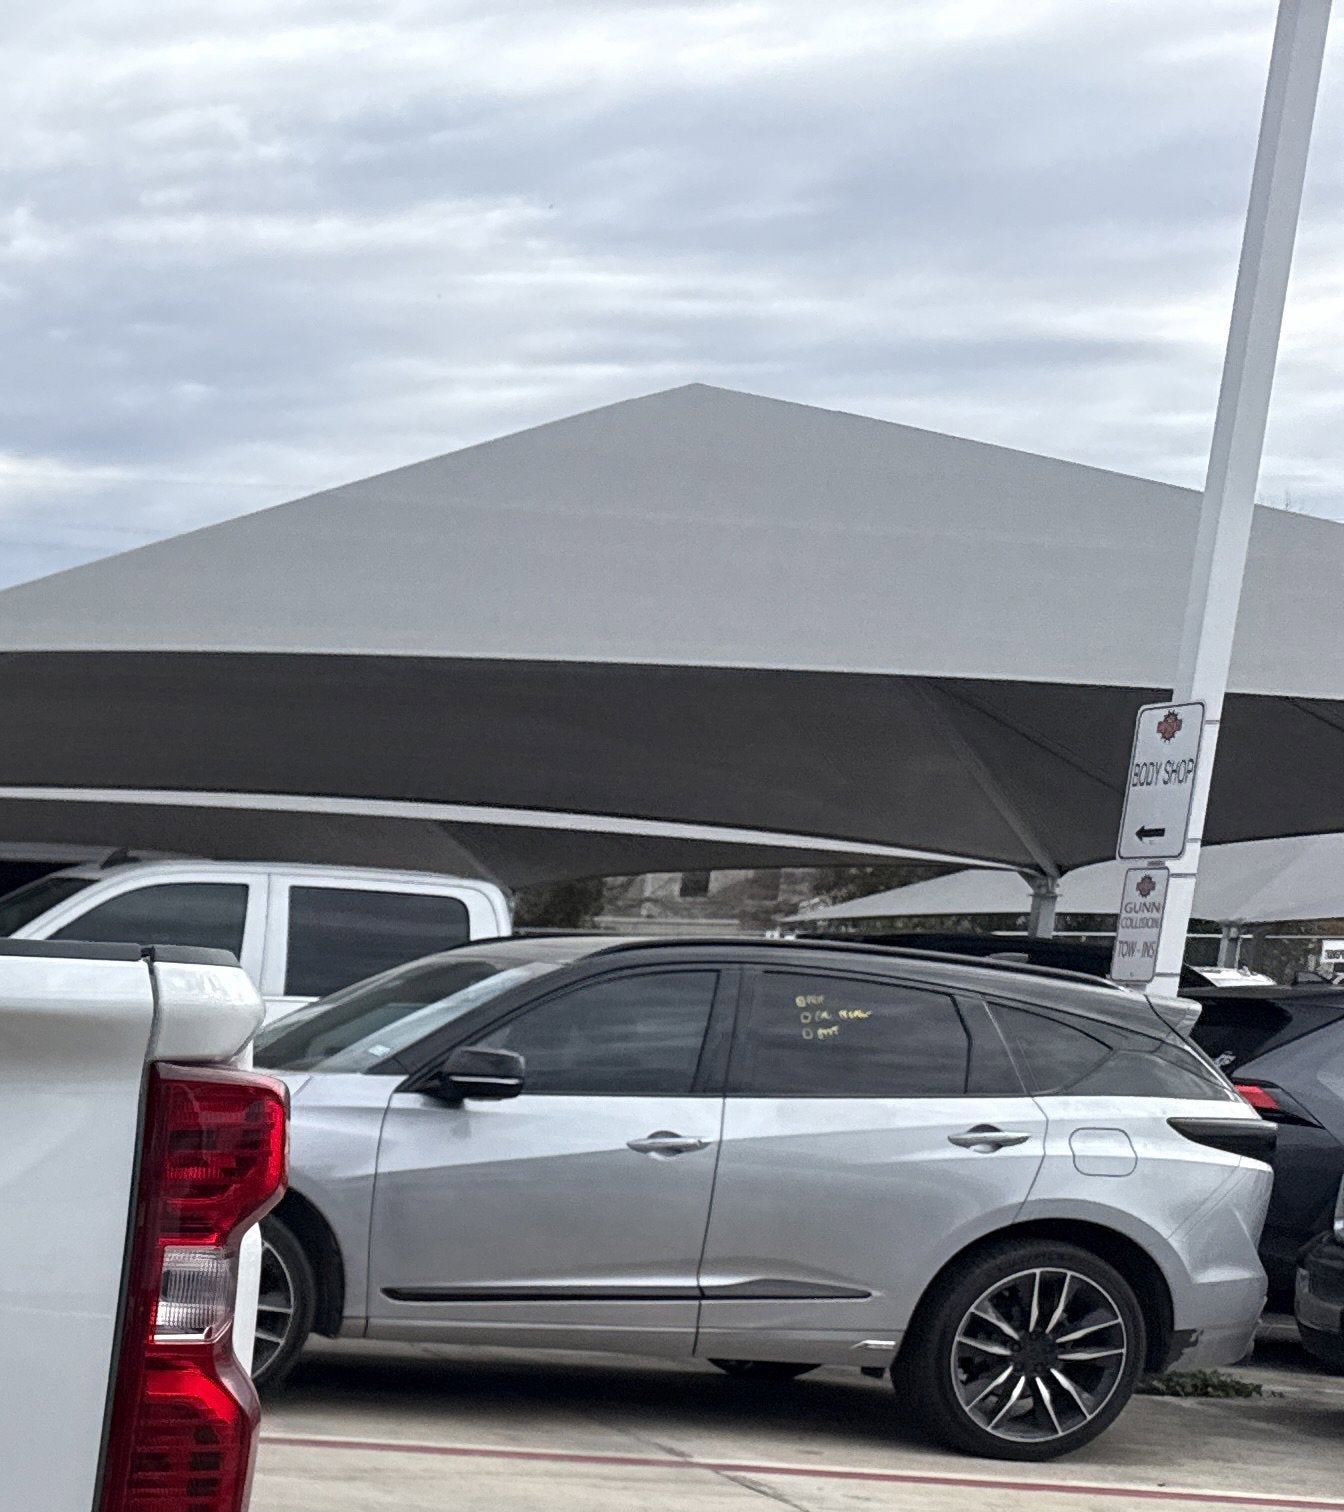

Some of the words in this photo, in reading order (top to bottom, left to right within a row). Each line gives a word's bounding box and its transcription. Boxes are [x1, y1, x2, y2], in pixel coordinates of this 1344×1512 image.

[1132, 762, 1162, 787] BODY
[1163, 758, 1194, 785] SHOP
[1124, 902, 1161, 914] GUNN
